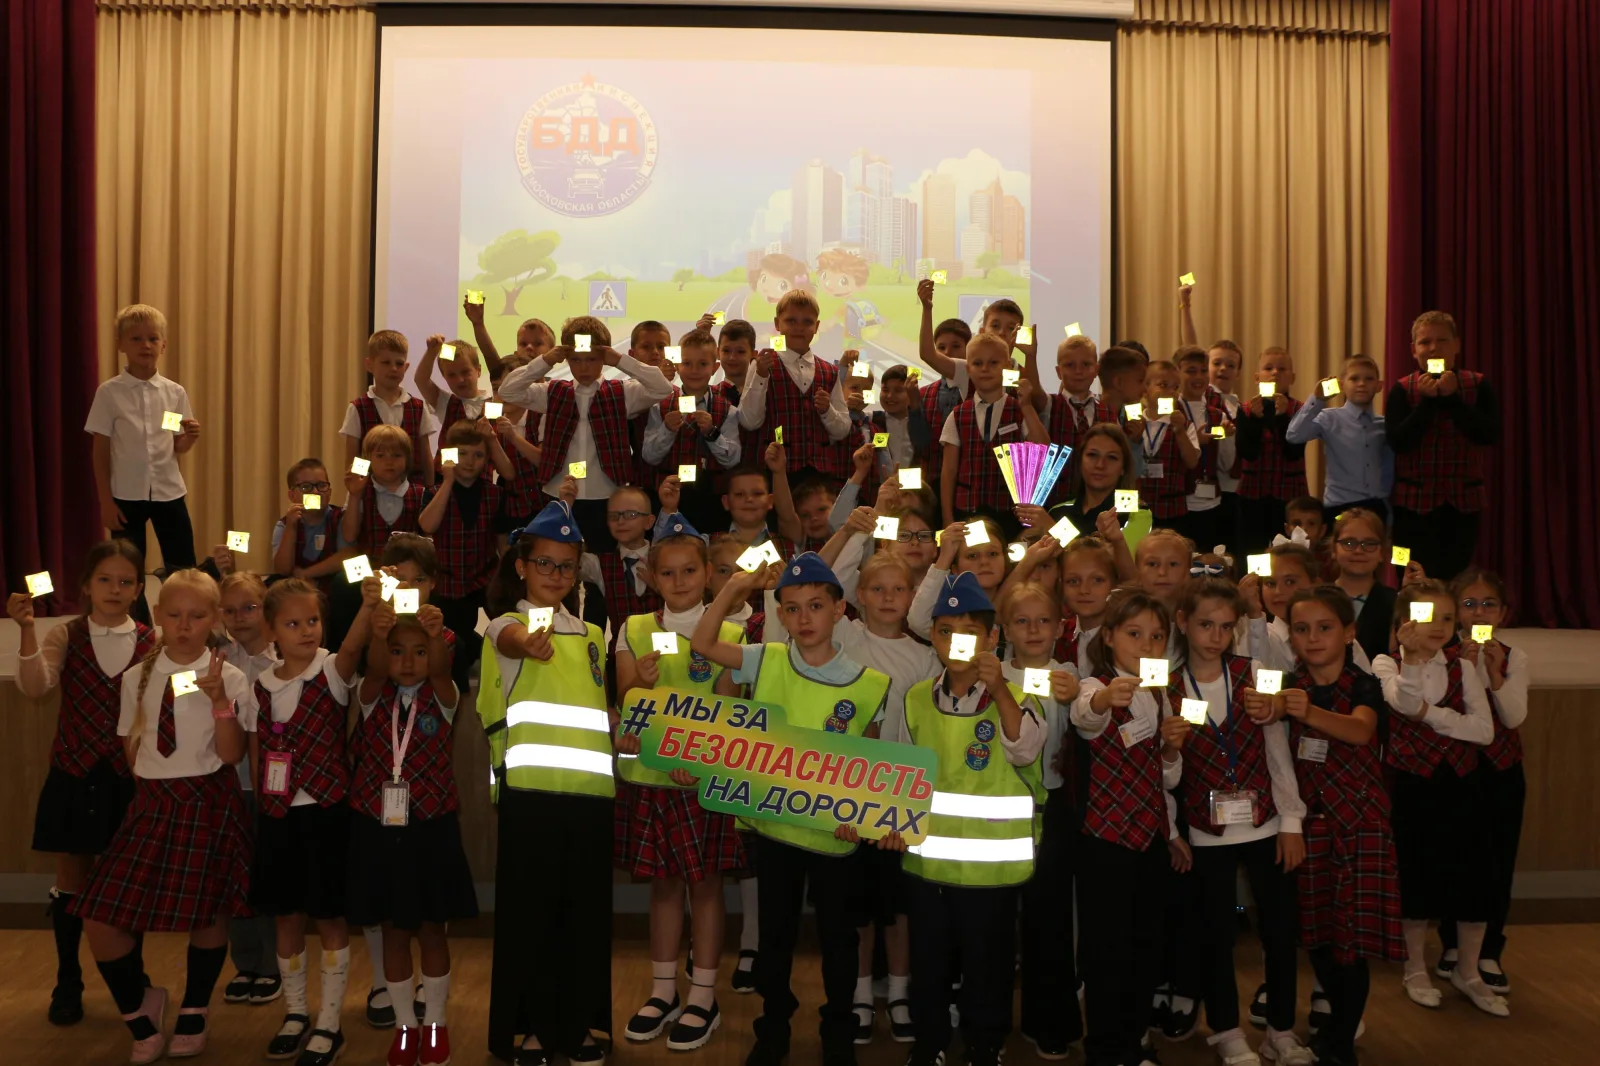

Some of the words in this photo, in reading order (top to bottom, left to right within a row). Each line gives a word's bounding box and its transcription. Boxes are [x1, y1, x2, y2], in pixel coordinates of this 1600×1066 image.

[532, 117, 640, 156] БДД
[527, 176, 594, 212] МОСКОВСКАЯ
[598, 177, 647, 210] ОБЛАСТЬ
[726, 703, 769, 732] ЗА
[656, 725, 933, 801] БЕЗОПАСНОСТЬ
[703, 774, 751, 806] НА
[756, 785, 929, 836] ДОРОГАХ
